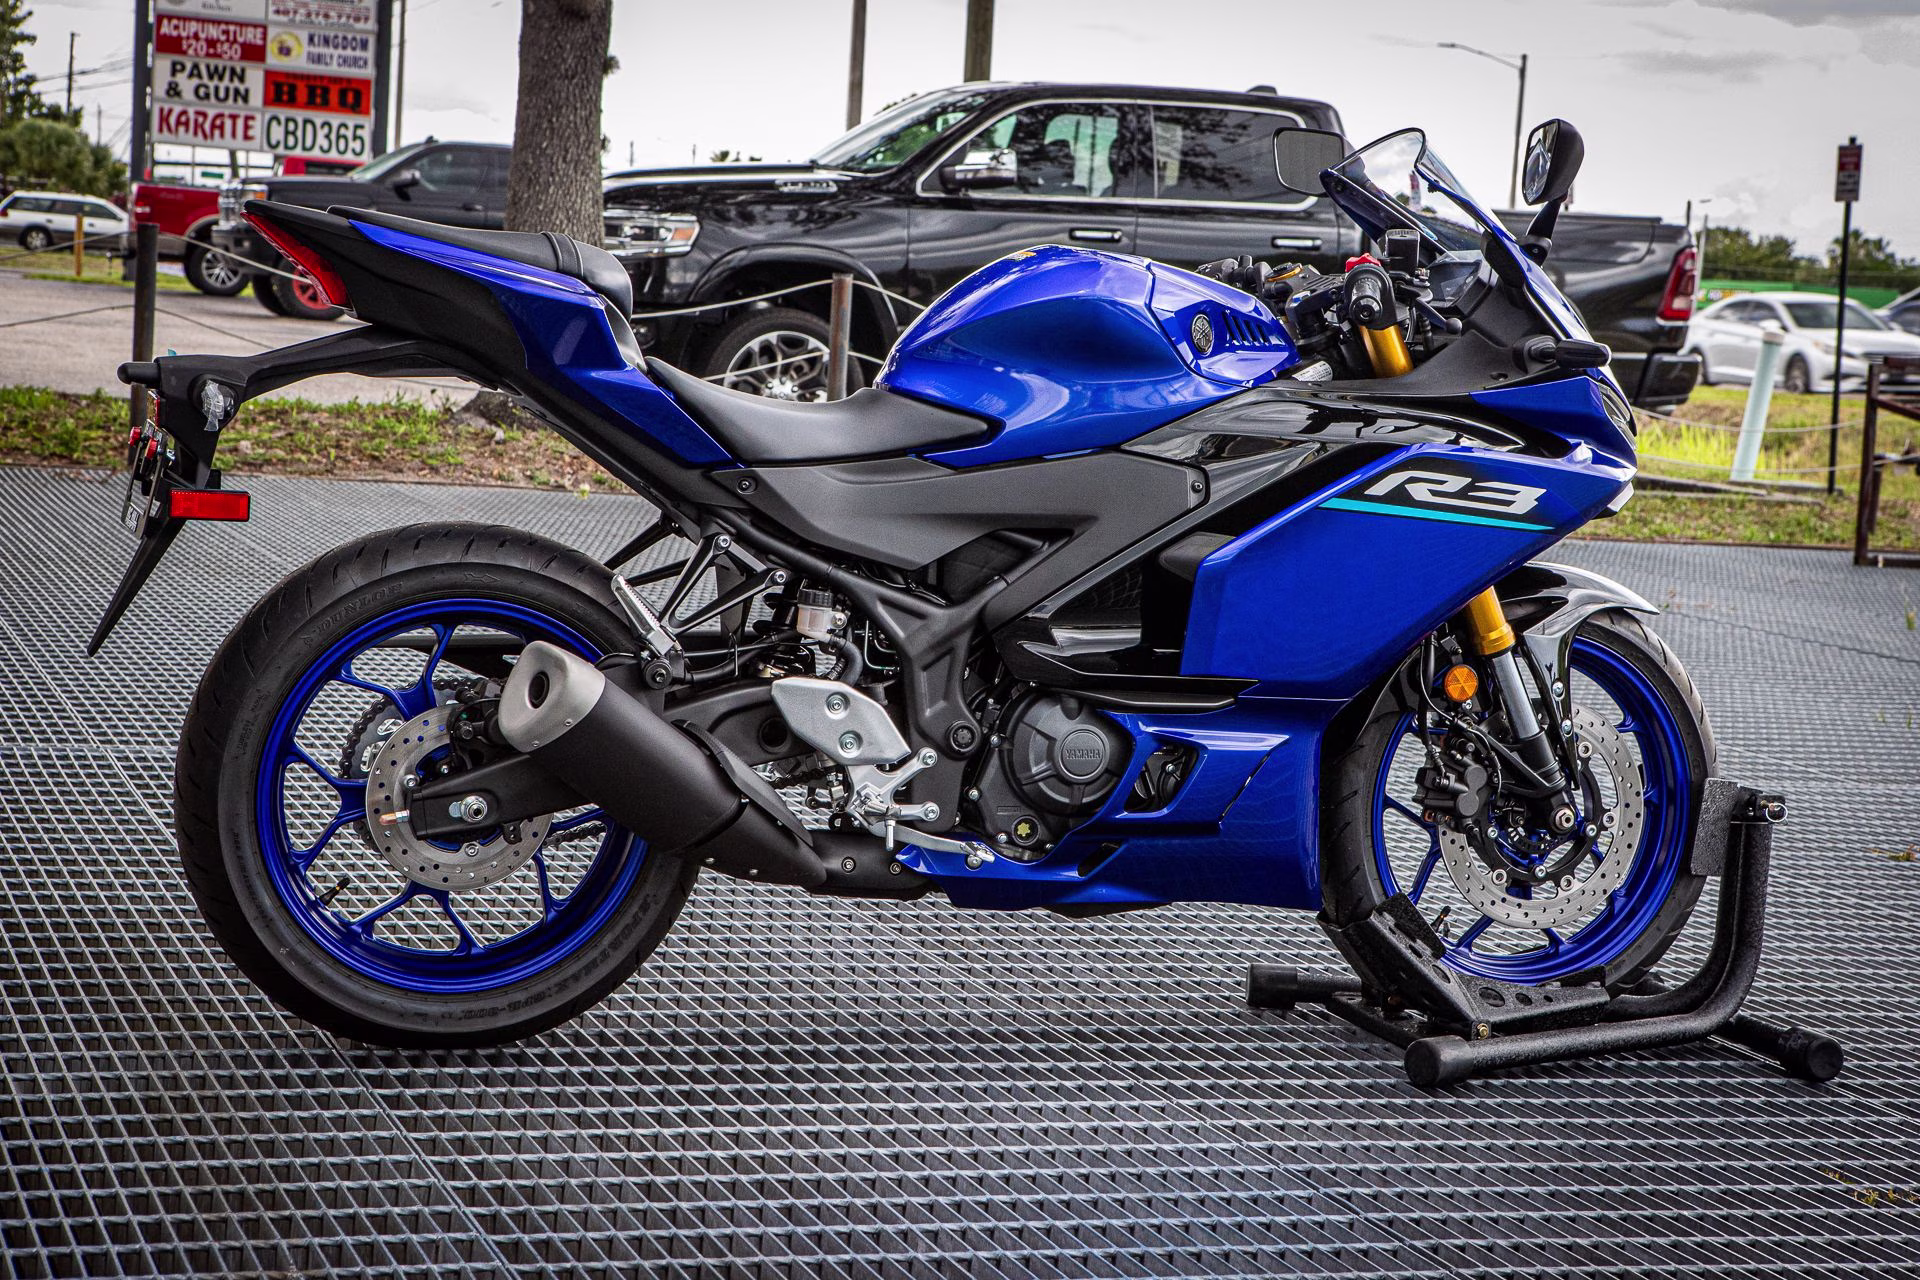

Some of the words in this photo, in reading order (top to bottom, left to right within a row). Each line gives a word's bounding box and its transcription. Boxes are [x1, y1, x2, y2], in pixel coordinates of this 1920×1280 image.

[160, 17, 264, 45] ACUPUNCTURE
[308, 32, 369, 51] KINGDOM
[306, 50, 334, 66] FAMILY
[337, 54, 369, 69] CHURCH
[171, 61, 246, 84] PAWN
[166, 80, 182, 99] &
[194, 82, 249, 104] GUN
[158, 106, 256, 141] KARATE
[266, 114, 366, 156] CBD365
[1363, 470, 1548, 515] R3
[1065, 748, 1101, 760] YAMAHA
